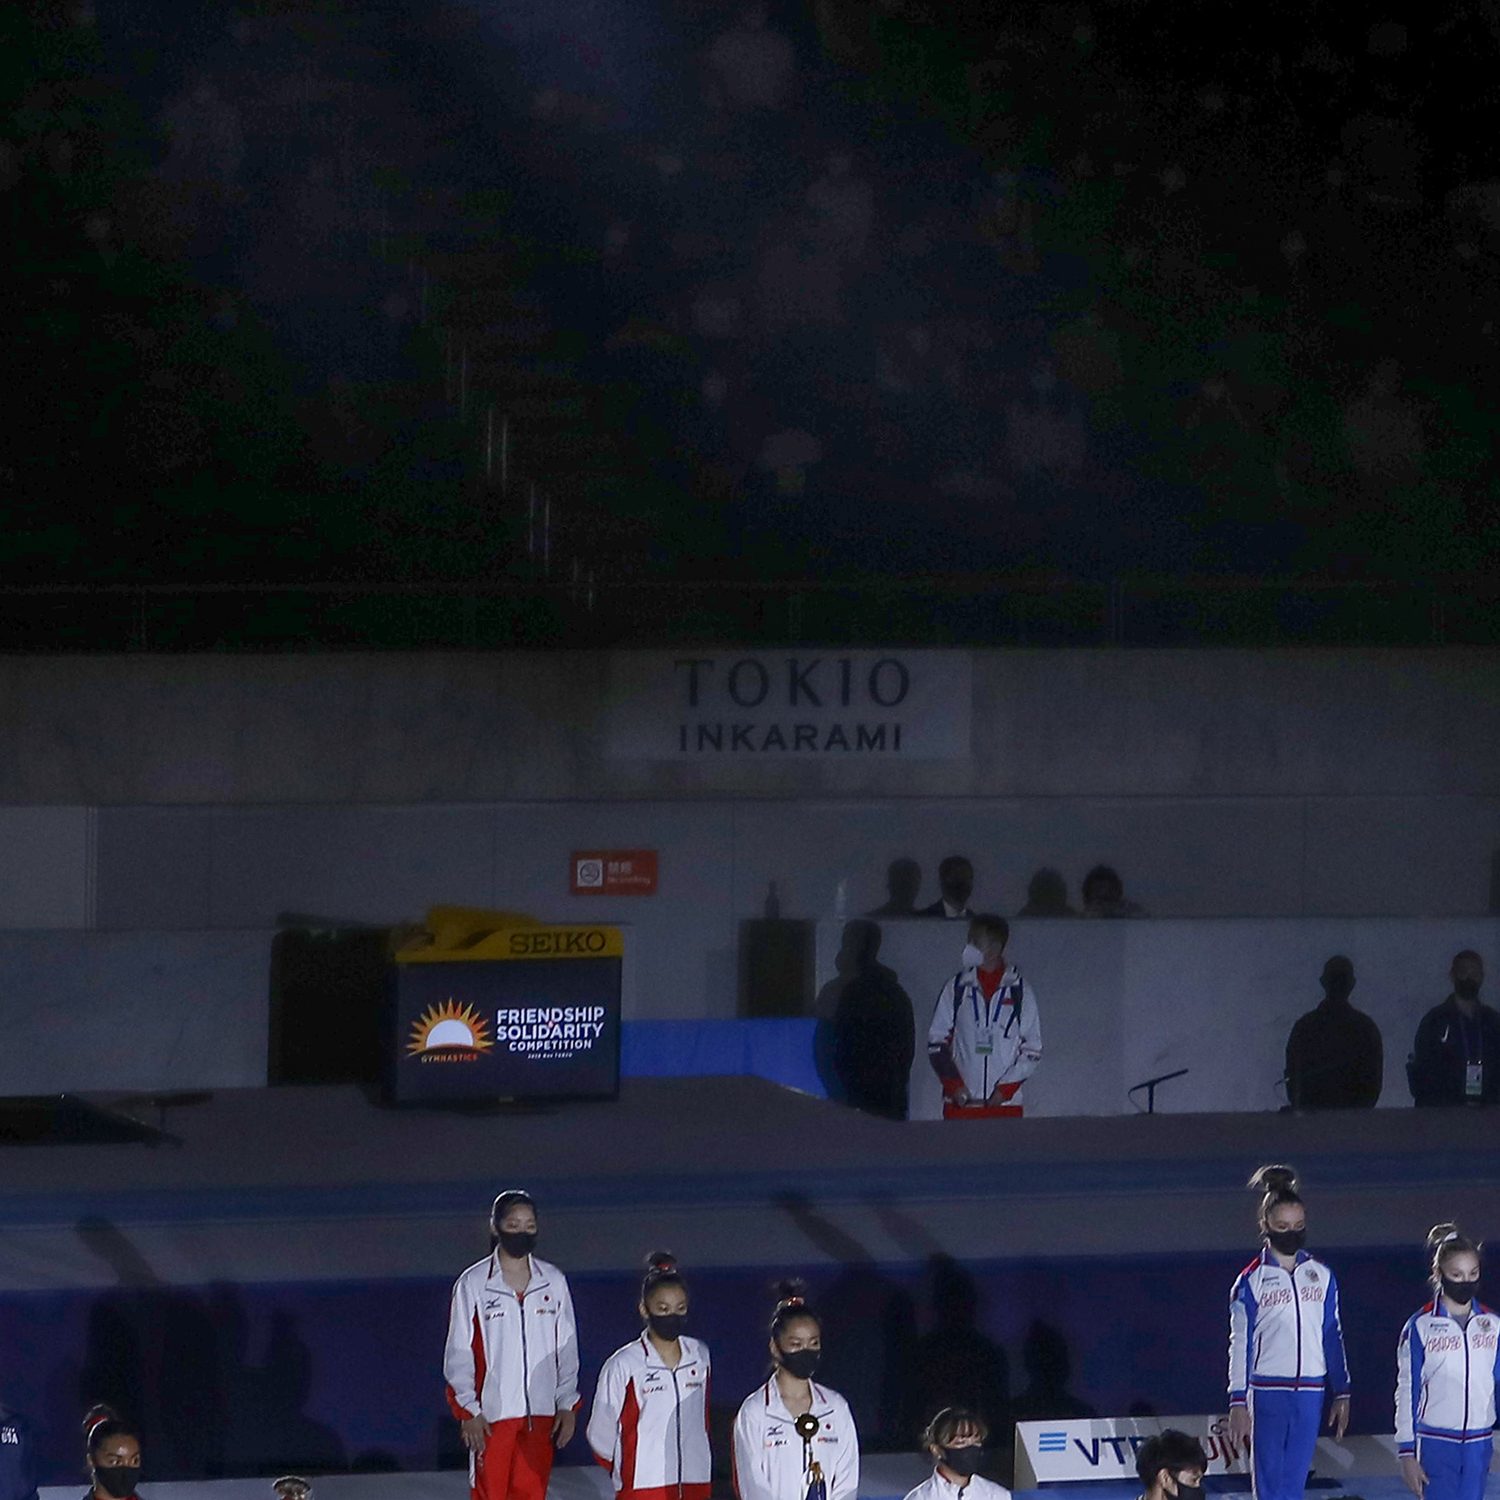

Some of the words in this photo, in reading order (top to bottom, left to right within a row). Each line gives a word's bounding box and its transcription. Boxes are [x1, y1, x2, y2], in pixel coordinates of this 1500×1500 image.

[674, 658, 910, 708] TOKIO
[680, 723, 902, 752] INKARAMI
[509, 931, 606, 954] SEIKO
[496, 1006, 606, 1026] FRIENDSHIP
[496, 1022, 605, 1041] SOLIDARITY
[509, 1038, 593, 1052] COMPETITION
